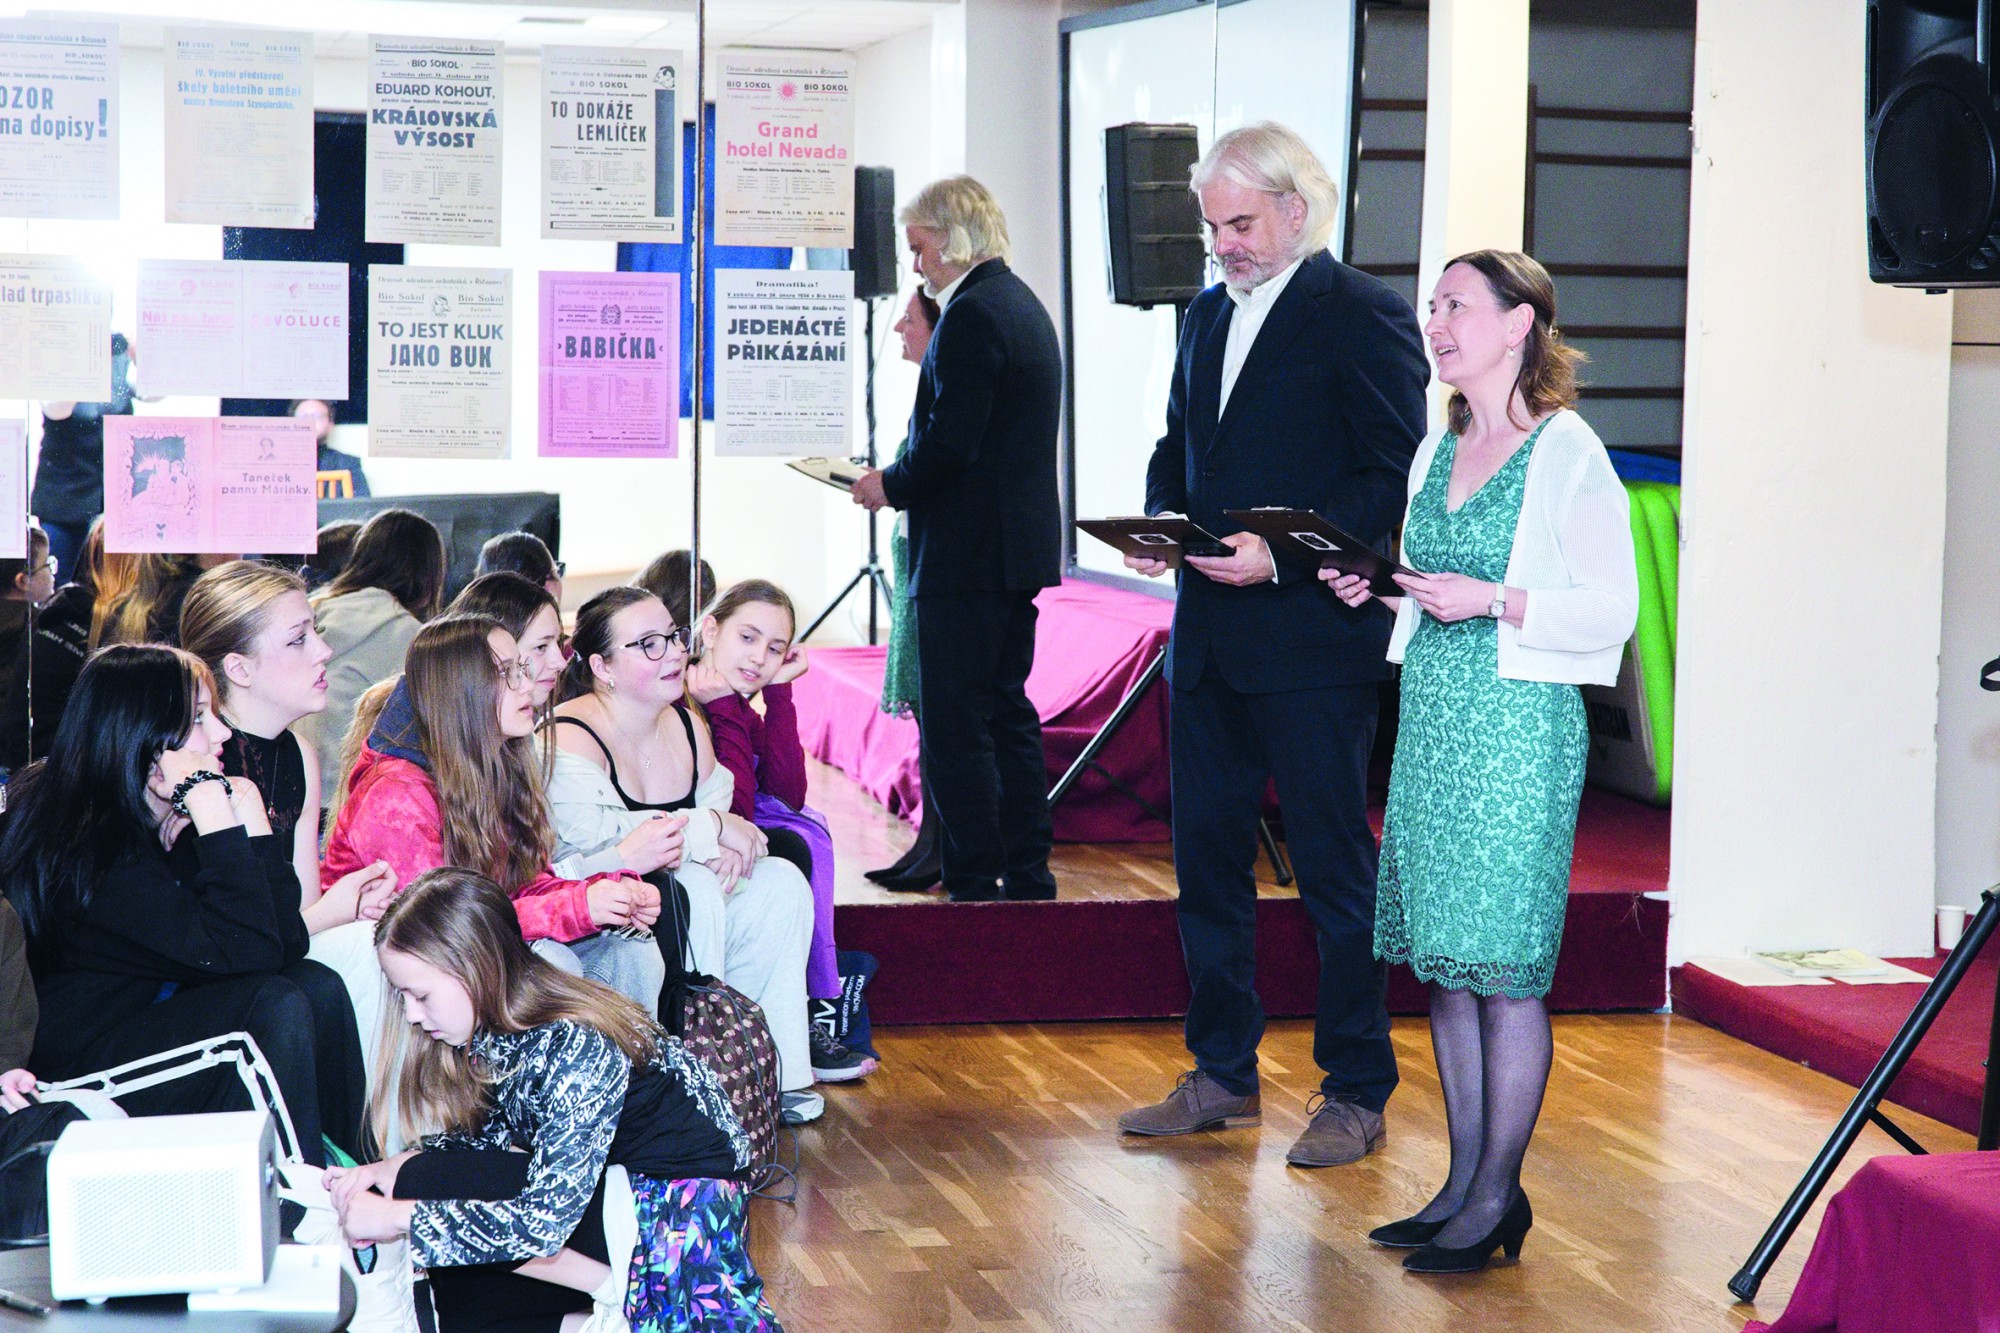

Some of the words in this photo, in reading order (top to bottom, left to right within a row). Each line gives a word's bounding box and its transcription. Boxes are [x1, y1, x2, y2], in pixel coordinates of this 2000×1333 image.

[411, 59, 428, 68] BIO
[430, 58, 460, 70] SOKOL
[375, 83, 430, 96] EDUARD
[435, 84, 496, 100] KOHOUT,
[579, 80, 596, 88] BIO
[599, 81, 629, 89] SOKOL
[727, 80, 742, 88] BIO
[744, 82, 771, 90] SOKOL
[804, 83, 820, 91] BIO
[821, 84, 849, 92] SOKOL
[372, 106, 497, 128] KRÁLOVSKÁ
[551, 101, 568, 118] TO
[577, 99, 633, 120] DOKÁŽE
[0, 116, 23, 135] na
[578, 122, 647, 143] LEMLÍČEK
[758, 121, 818, 139] Grand
[394, 127, 476, 149] VÝSOST
[727, 141, 773, 158] hotel
[779, 142, 847, 159] Nevada
[756, 280, 819, 289] Dramatika!
[378, 292, 394, 301] Bio
[398, 292, 424, 301] Sokol
[458, 294, 474, 302] Bio
[478, 294, 504, 303] Sokol
[378, 321, 404, 338] TO
[409, 322, 449, 339] JEST
[454, 323, 504, 341] KLUK
[727, 315, 846, 337] JEDENÁCTÉ
[390, 343, 440, 367] JAKO
[565, 332, 657, 360] BABIČKA
[727, 340, 846, 362] PŘIKÁZÁNÍ
[242, 471, 292, 483] Taneček
[221, 486, 257, 496] panny
